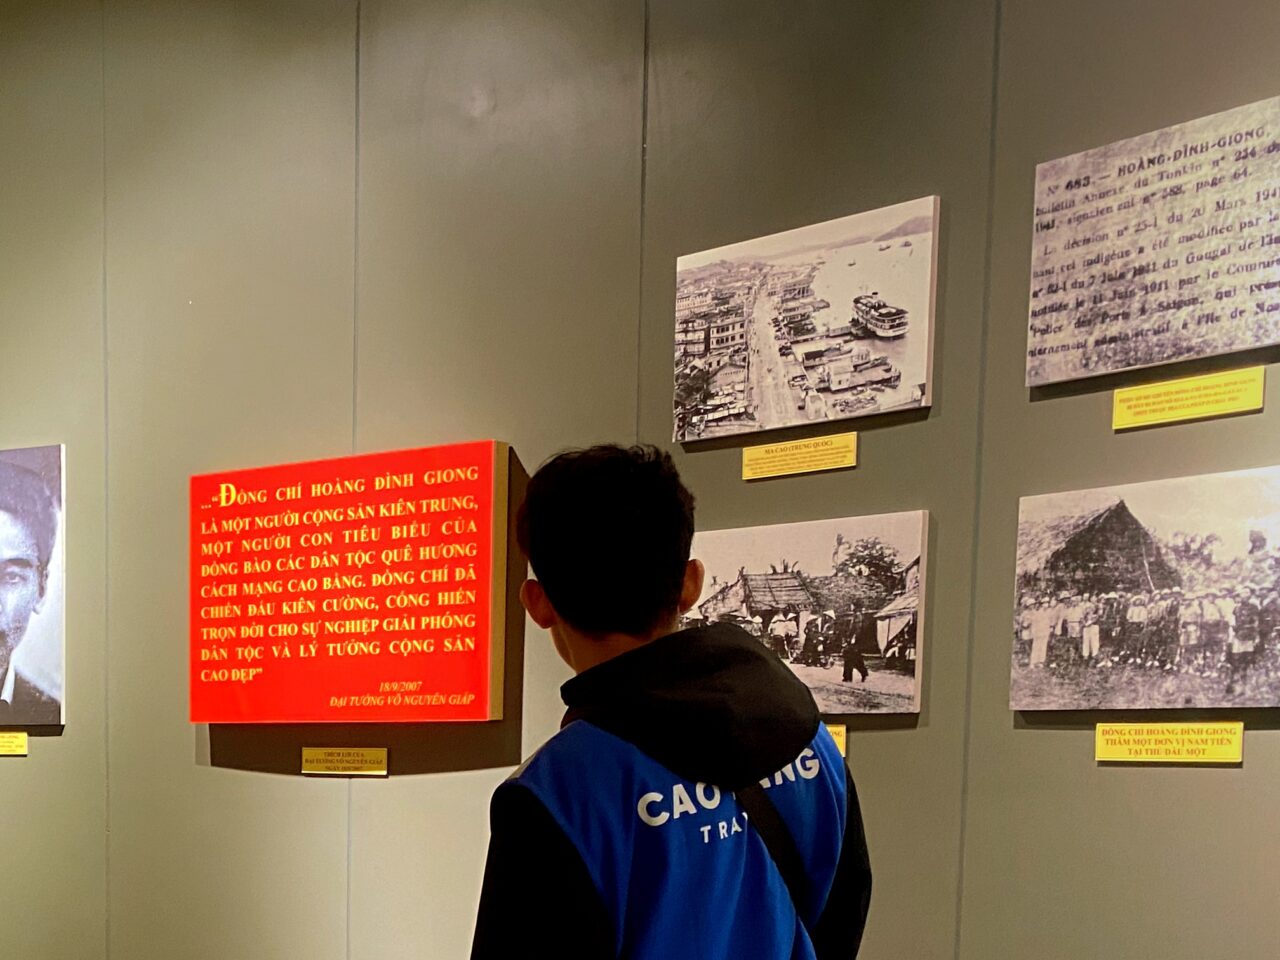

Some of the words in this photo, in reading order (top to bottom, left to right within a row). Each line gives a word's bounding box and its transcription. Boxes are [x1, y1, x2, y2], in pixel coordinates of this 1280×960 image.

[275, 482, 302, 501] CHÍ
[311, 477, 366, 497] HOÀNG
[374, 472, 414, 491] ĐÌNH
[423, 466, 479, 485] GIONG
[201, 518, 218, 535] LÀ
[221, 517, 251, 534] MỘT
[254, 510, 300, 530] NGƯỜI
[302, 508, 344, 527] CỘNG
[347, 503, 376, 521] SẢN
[379, 498, 416, 517] KIÊN
[419, 495, 479, 513] TRUNG,
[201, 540, 233, 558] MỘT
[241, 533, 291, 553] NGƯỜI
[300, 532, 333, 547] CON
[342, 524, 381, 544] TIÊU
[391, 520, 431, 540] BIỂU
[441, 516, 477, 535] CỦA
[201, 561, 238, 577] ĐỒNG
[243, 557, 271, 574] BÀO
[276, 553, 305, 572] CÁC
[310, 551, 340, 569] DÂN
[345, 550, 376, 569] TỘC
[381, 544, 413, 566] QUÊ
[419, 543, 477, 561] HƯƠNG
[201, 582, 237, 598] CÁCH
[242, 580, 283, 598] MẠNG
[287, 578, 318, 593] CAO
[322, 572, 366, 590] BẰNG.
[371, 569, 415, 587] ĐỒNG
[420, 564, 448, 583] CHÍ
[454, 563, 476, 582] ĐÃ
[201, 602, 241, 619] CHIẾN
[247, 600, 275, 617] ĐẤU
[282, 597, 316, 615] KIÊN
[322, 594, 379, 612] CƯỜNG,
[385, 591, 430, 609] CỐNG
[437, 587, 476, 606] HIẾN
[201, 626, 236, 642] TRỌN
[240, 621, 264, 638] ĐỜI
[268, 623, 298, 637] CHO
[302, 620, 321, 638] SỰ
[324, 618, 379, 636] NGHIỆP
[382, 614, 416, 631] GIẢI
[421, 611, 476, 630] PHÓNG
[201, 645, 228, 661] DÂN
[235, 645, 264, 663] TỘC
[272, 642, 291, 658] VÀ
[299, 641, 319, 658] LÝ
[326, 639, 380, 656] TƯỞNG
[389, 638, 435, 657] CỘNG
[443, 634, 476, 652] SẢN
[201, 669, 228, 682] CAO
[379, 681, 423, 692] 18/9/2007
[330, 696, 347, 708] ĐẠI
[350, 695, 384, 706] TƯỚNG
[387, 694, 402, 705] VÕ
[449, 691, 475, 705] GIÁP
[637, 781, 721, 827] CAO
[700, 811, 749, 843] TRA
